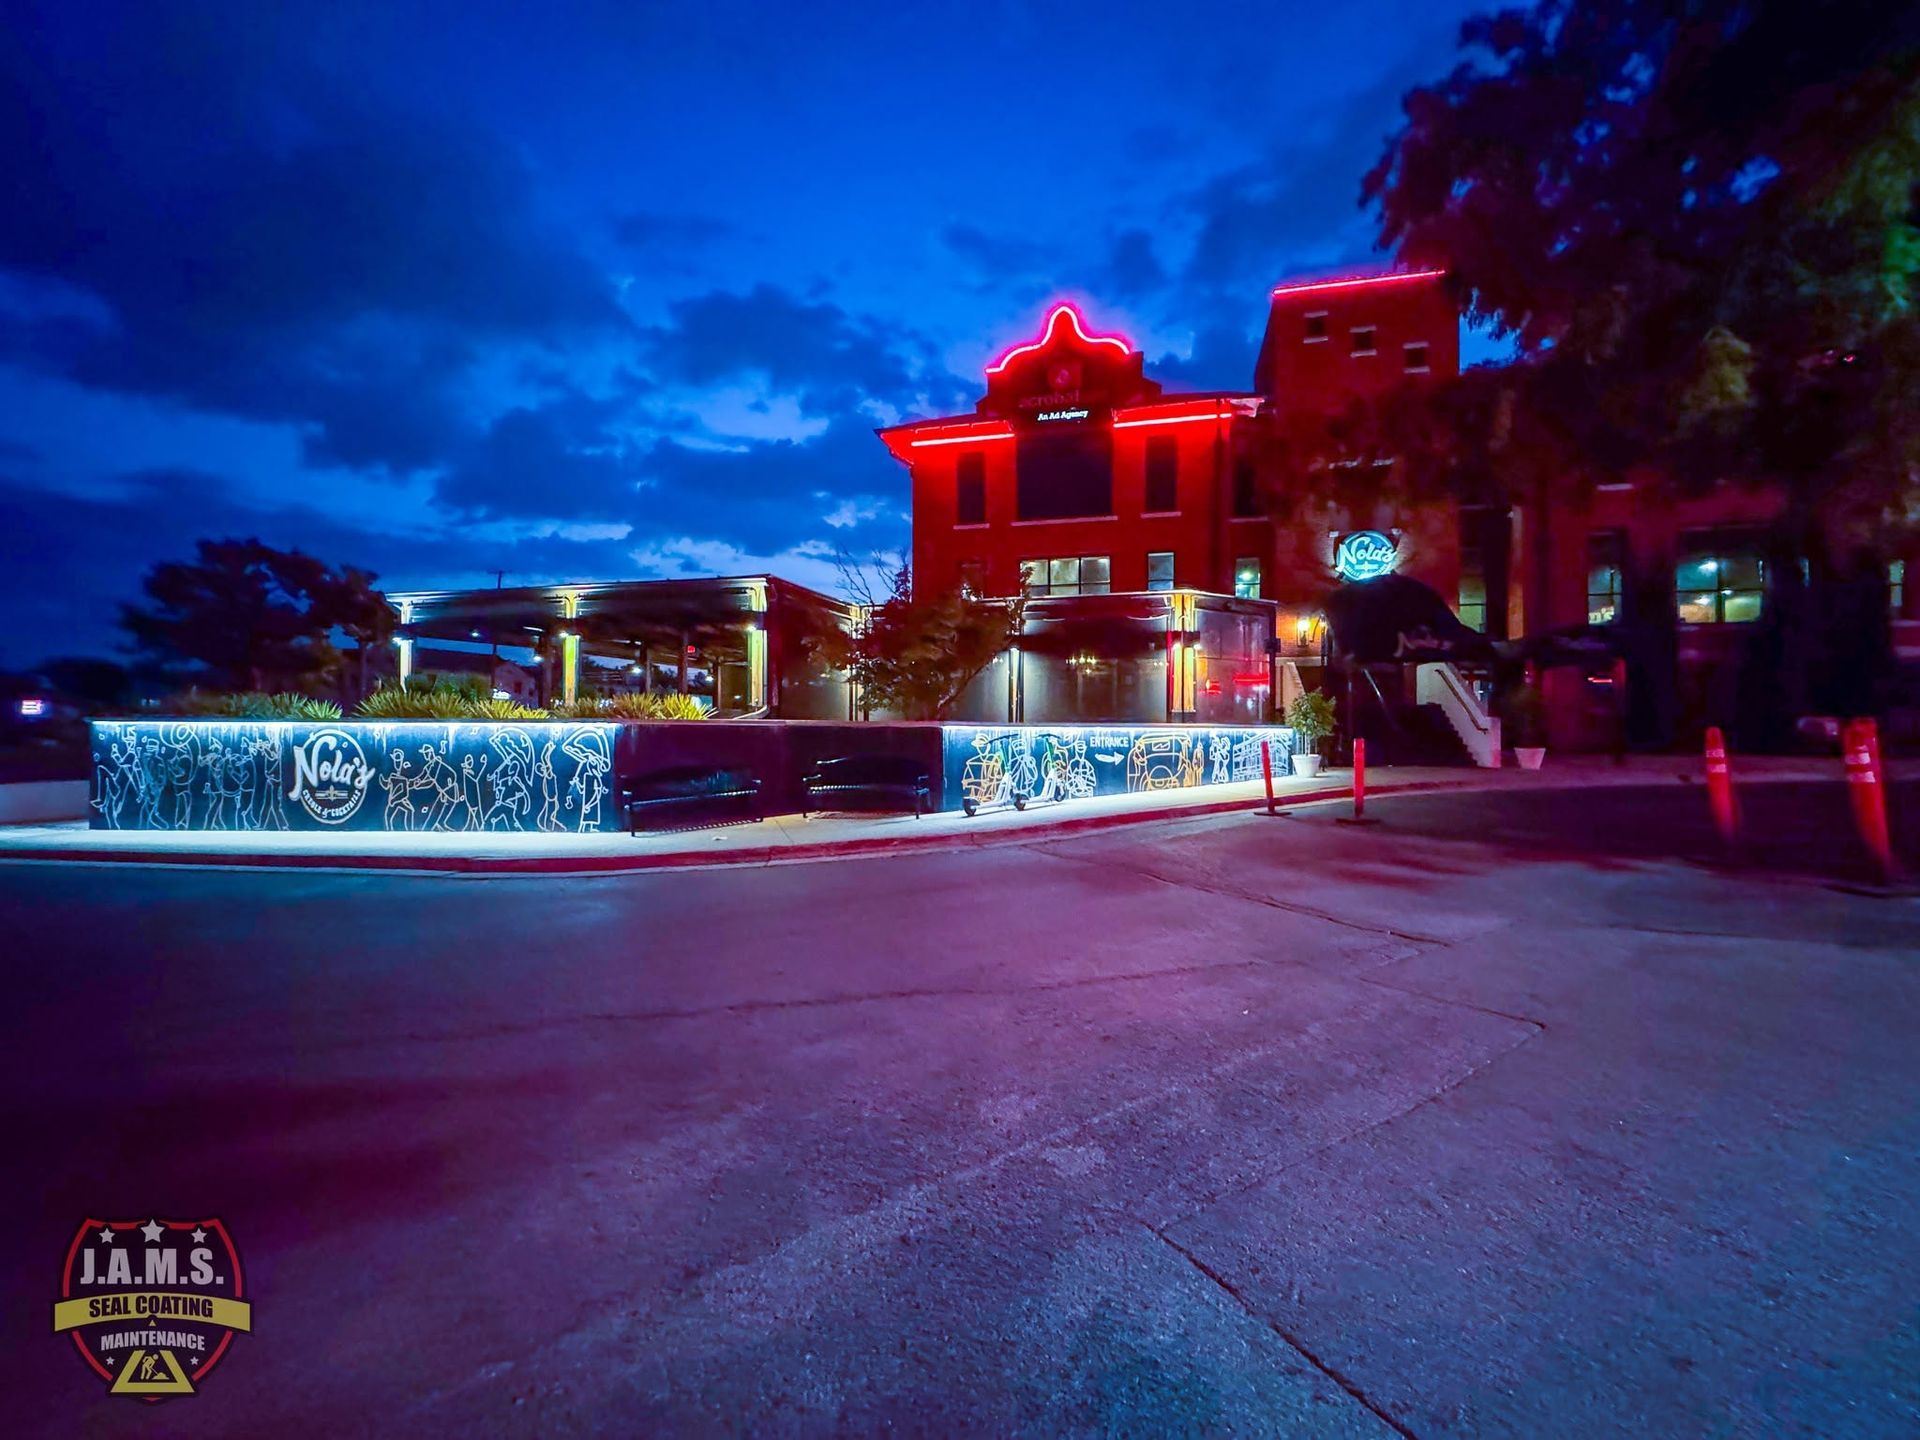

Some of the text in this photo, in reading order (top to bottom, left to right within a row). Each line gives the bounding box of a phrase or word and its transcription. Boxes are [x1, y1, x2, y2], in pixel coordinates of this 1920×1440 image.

[1335, 536, 1397, 572] Nola's
[1089, 736, 1129, 748] ENTRANCE
[287, 735, 376, 801] Nola's
